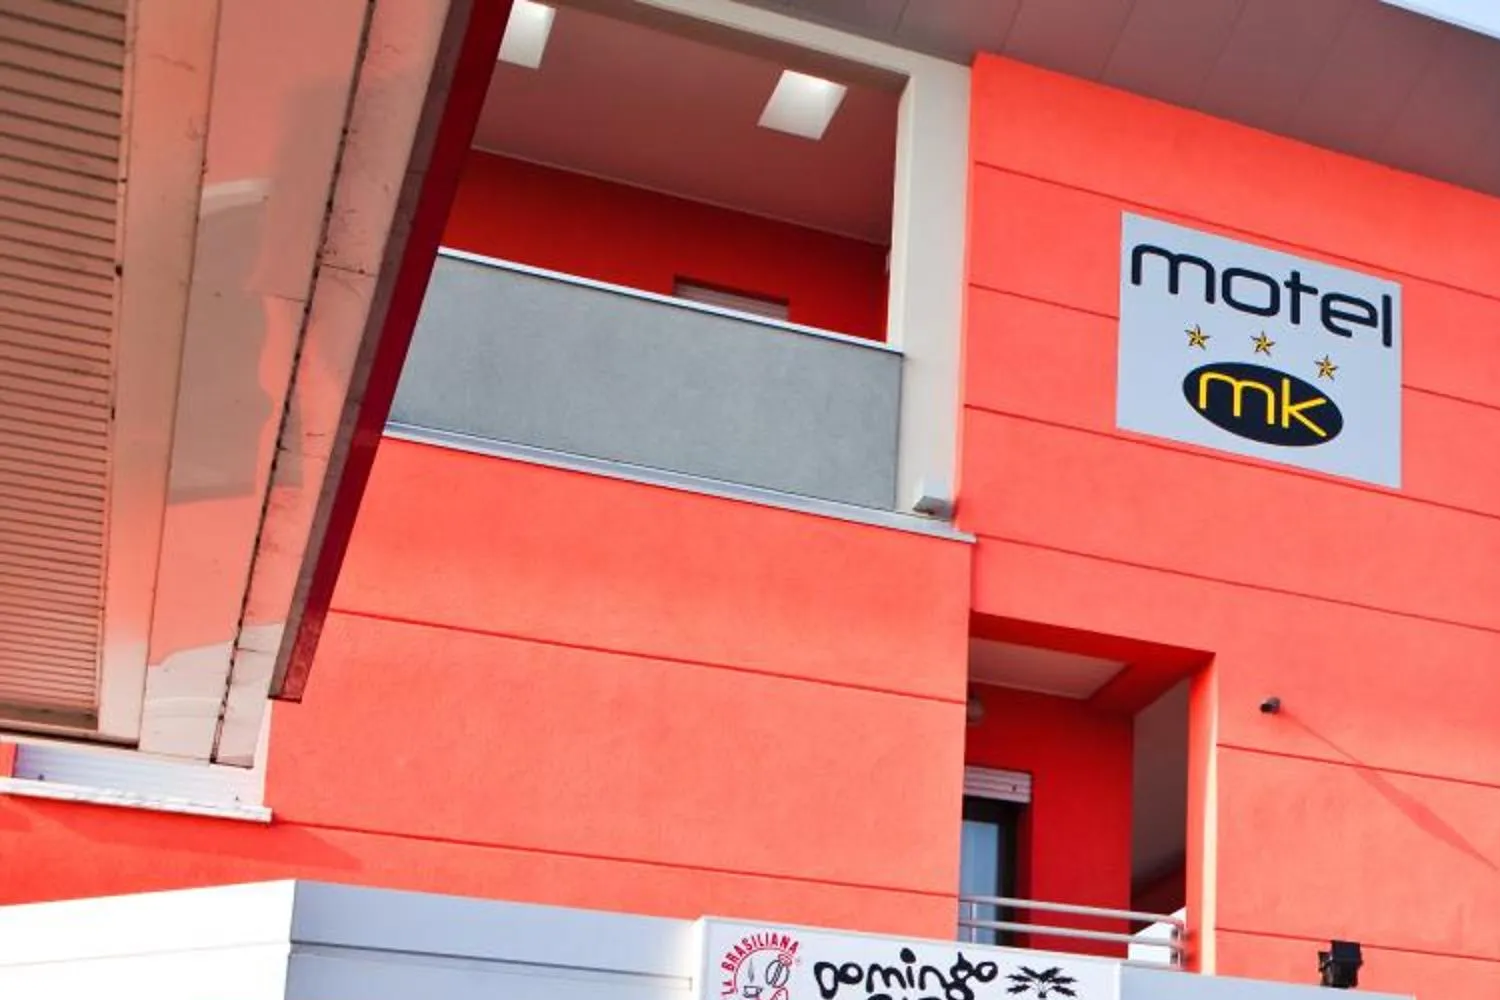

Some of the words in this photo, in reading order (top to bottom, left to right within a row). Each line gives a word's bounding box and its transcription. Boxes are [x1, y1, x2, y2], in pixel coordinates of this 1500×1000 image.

[1131, 243, 1392, 348] motel
[1198, 371, 1328, 437] mk
[721, 931, 799, 972] BRASILIANA
[721, 981, 733, 996] LA
